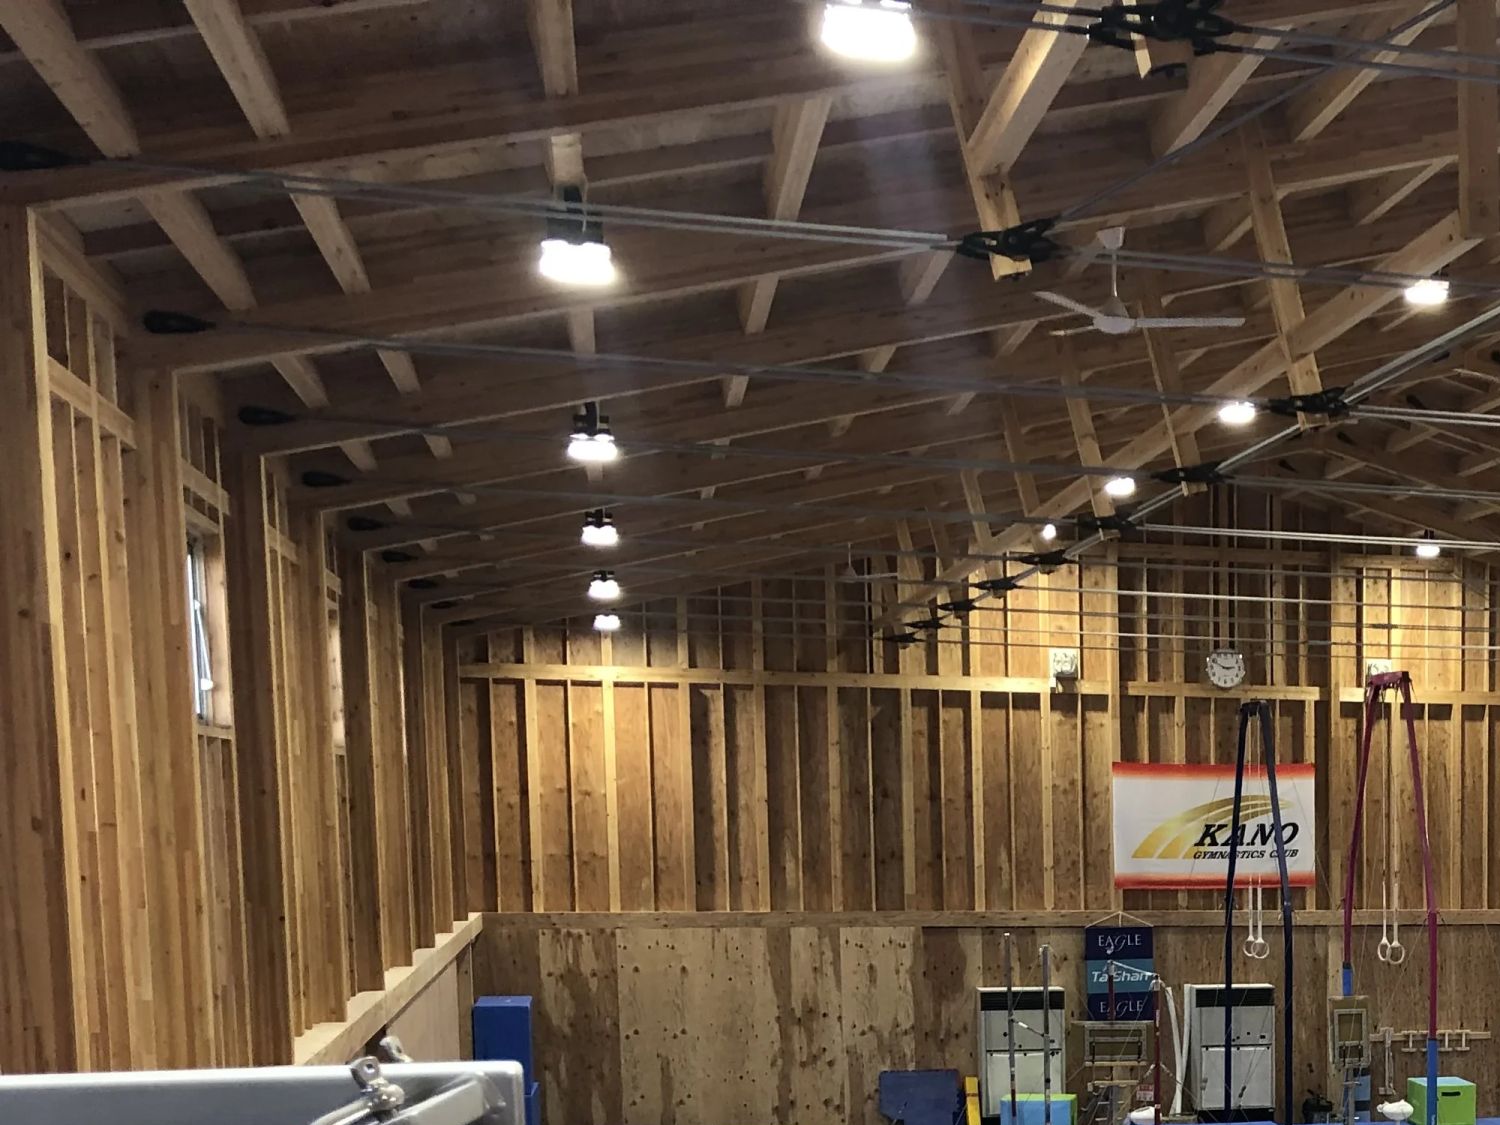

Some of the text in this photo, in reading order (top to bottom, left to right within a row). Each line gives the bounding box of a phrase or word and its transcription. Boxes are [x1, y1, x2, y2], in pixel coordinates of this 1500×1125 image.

[1193, 822, 1299, 847] KANO
[1269, 849, 1299, 858] CUB
[1098, 934, 1142, 951] EAGLE
[1092, 970, 1149, 983] TaShan
[1100, 1001, 1144, 1017] EGLE
